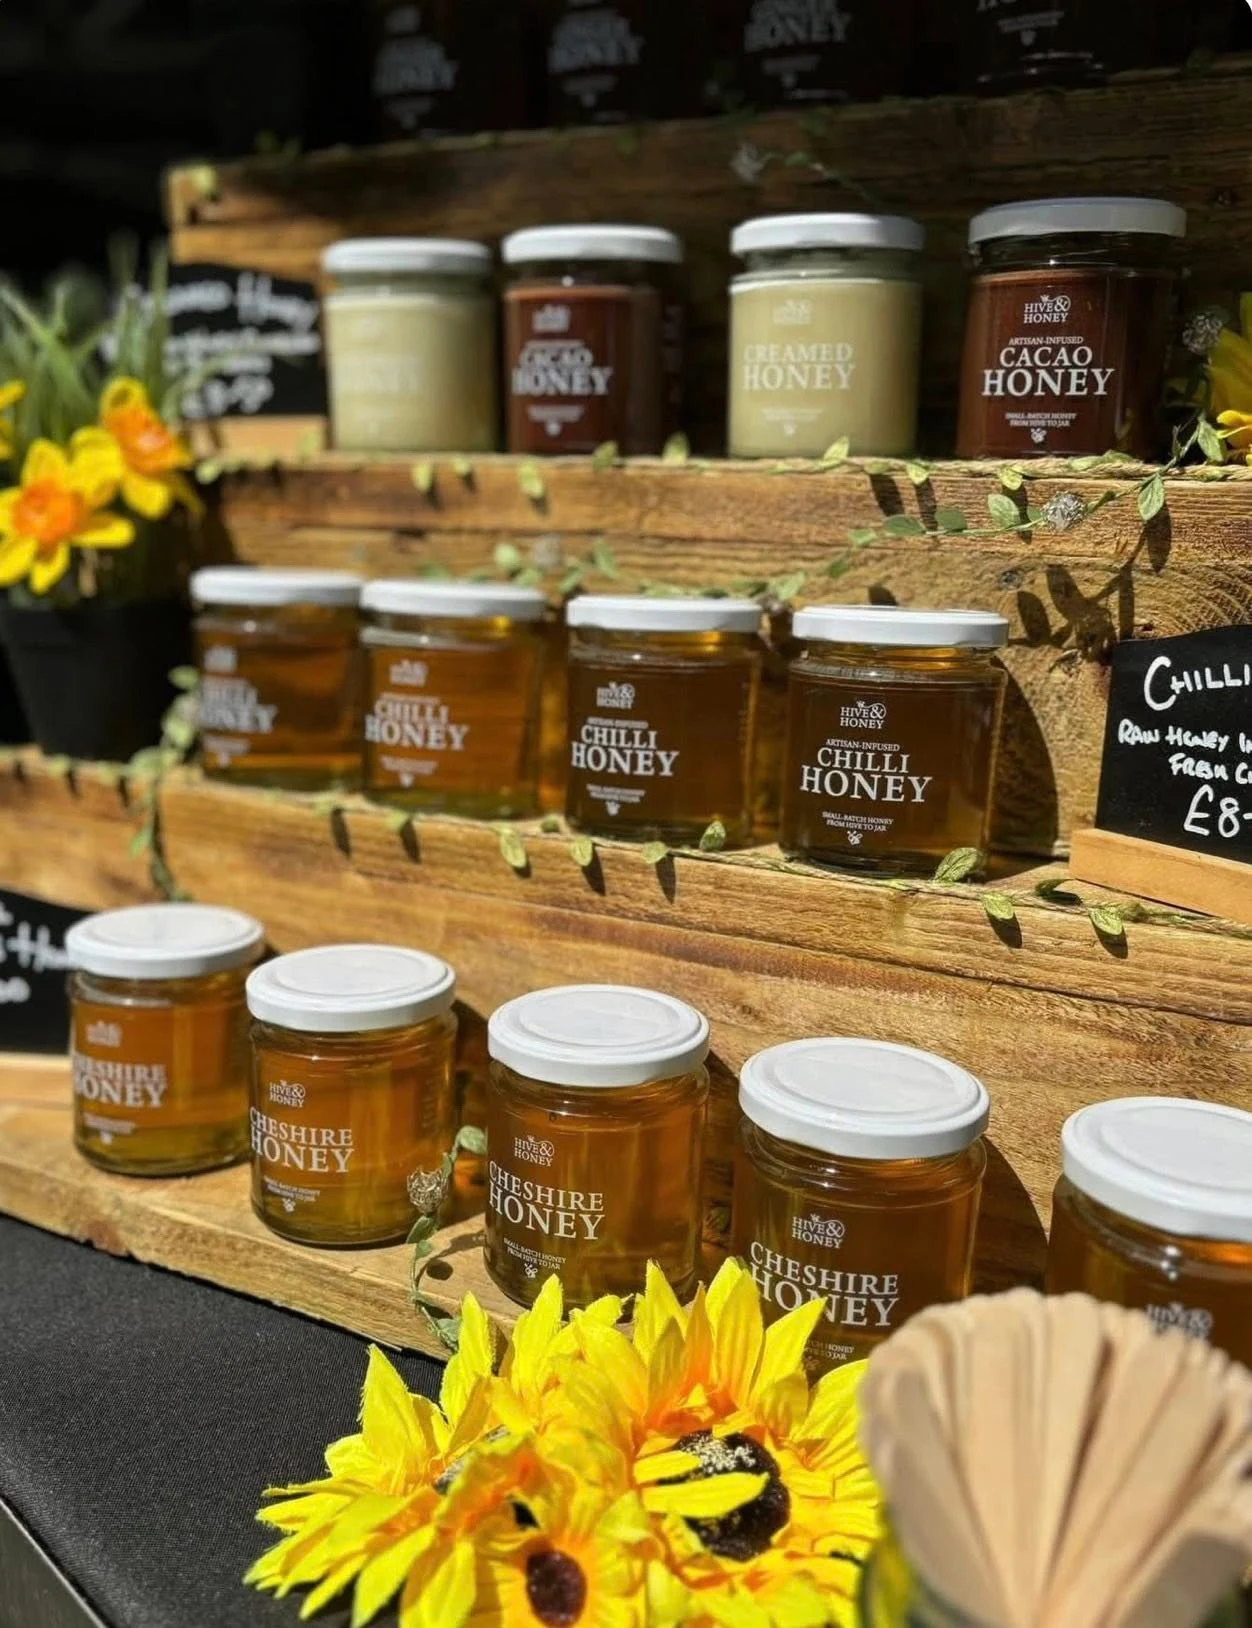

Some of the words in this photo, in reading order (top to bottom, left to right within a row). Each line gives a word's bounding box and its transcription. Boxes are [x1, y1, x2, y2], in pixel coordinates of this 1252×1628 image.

[1024, 312, 1068, 323] HONEY
[743, 342, 854, 363] CREAMED
[1008, 336, 1084, 346] ARTISAN-INFUSED
[1000, 346, 1093, 368] CACAO
[742, 363, 857, 390] HONEY
[981, 368, 1115, 397] HONEY
[1144, 655, 1251, 711] CHILLI
[364, 714, 470, 751] HONEY
[581, 724, 657, 749] CHILLI
[840, 717, 884, 729] HONEY
[1118, 718, 1160, 745] RAW
[1165, 725, 1230, 752] HONEY
[571, 741, 680, 777] HONEY
[826, 738, 900, 752] ARTISAN-INFUSED
[817, 747, 910, 773] CHILLI
[1168, 752, 1229, 781] FRESH
[800, 764, 933, 803] HONEY
[863, 823, 874, 831] TO
[874, 824, 887, 832] JAR
[269, 1093, 305, 1108] HONEY
[250, 1106, 353, 1147] CHESHIRE
[251, 1124, 355, 1173] HONEY
[514, 1147, 553, 1167] HONEY
[489, 1160, 604, 1212] CHESHIRE
[489, 1180, 605, 1240] HONEY
[792, 1227, 843, 1249] HONEY
[750, 1241, 899, 1295] CHESHIRE
[750, 1261, 899, 1326] HONEY
